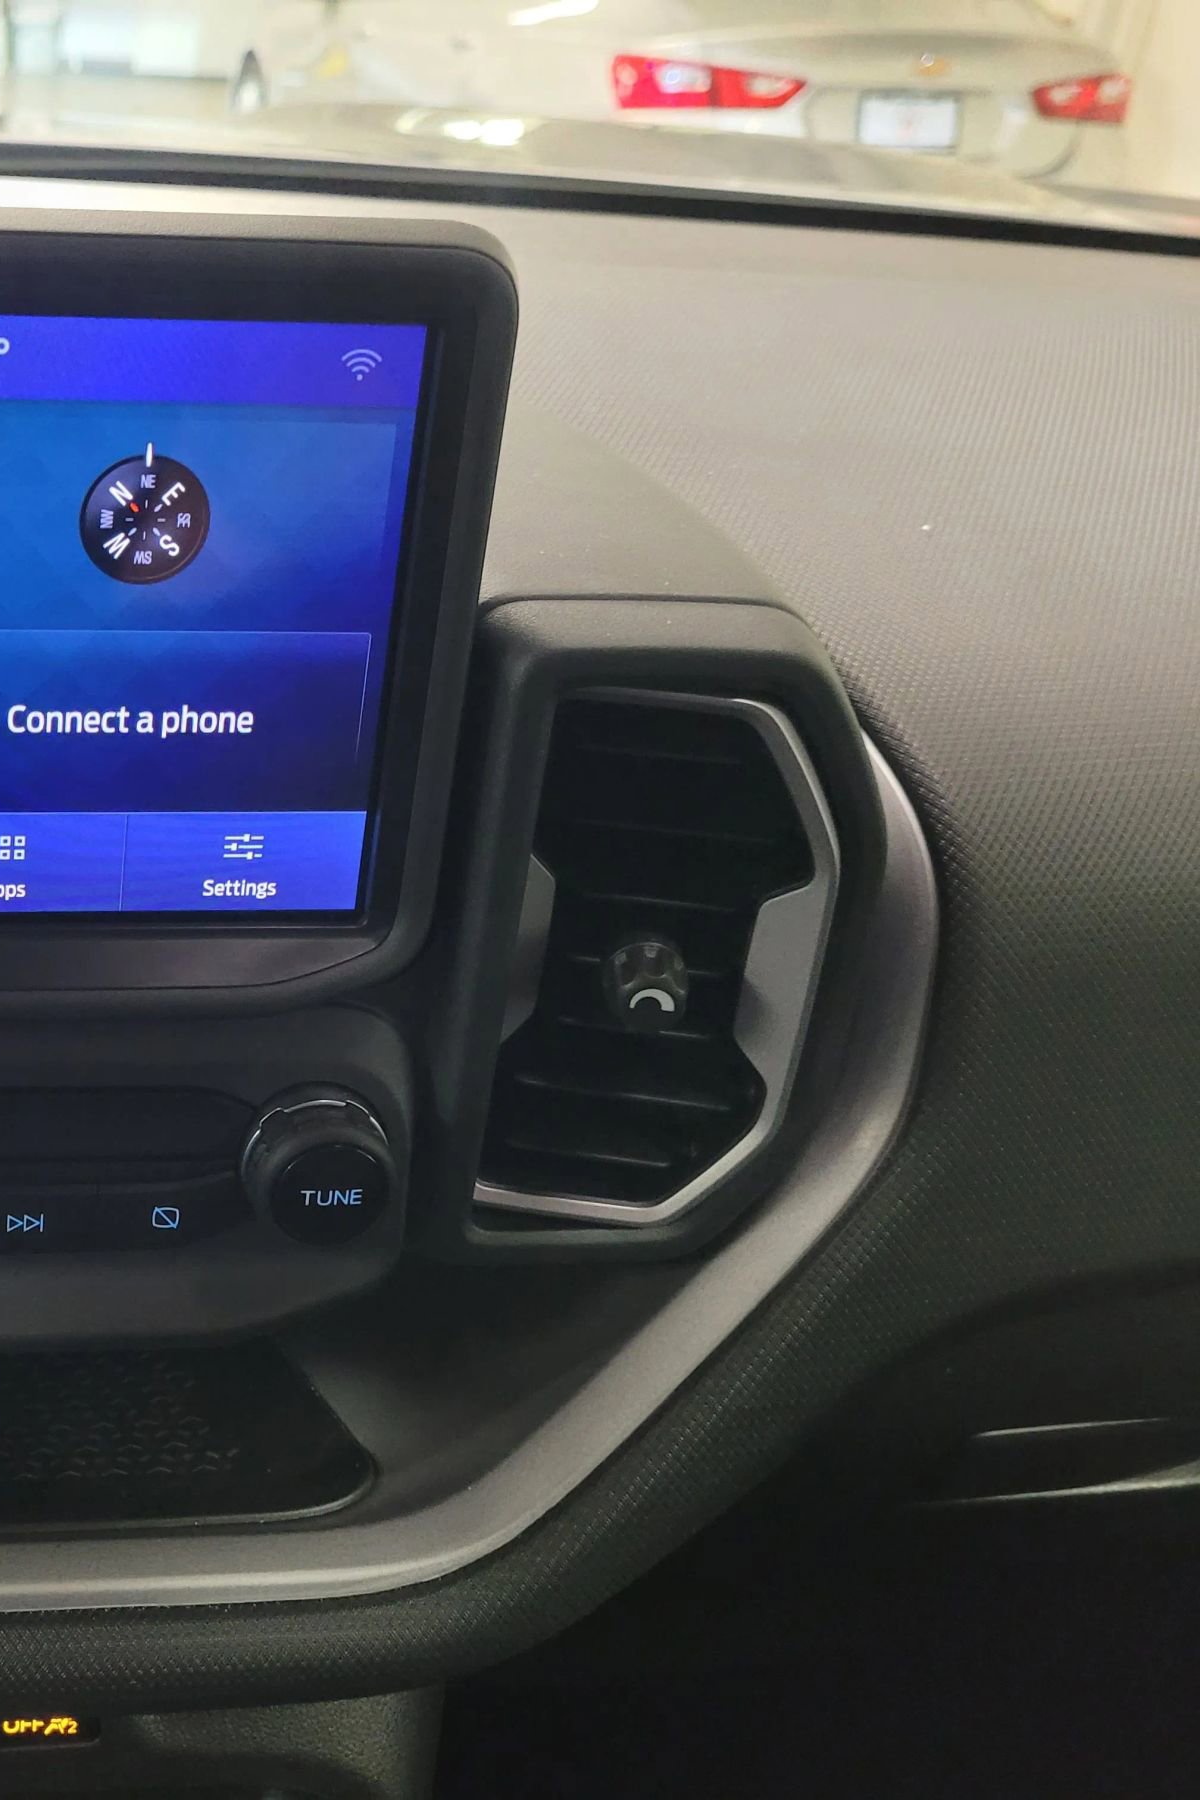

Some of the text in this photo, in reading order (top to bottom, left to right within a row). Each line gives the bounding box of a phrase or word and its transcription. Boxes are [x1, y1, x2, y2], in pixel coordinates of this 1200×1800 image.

[109, 480, 134, 506] N
[140, 474, 156, 489] NE
[161, 481, 186, 507] E
[103, 532, 131, 560] W
[159, 534, 180, 557] S
[6, 703, 255, 739] Connect a phone
[202, 879, 277, 898] Settings
[299, 1188, 364, 1206] TUNE
